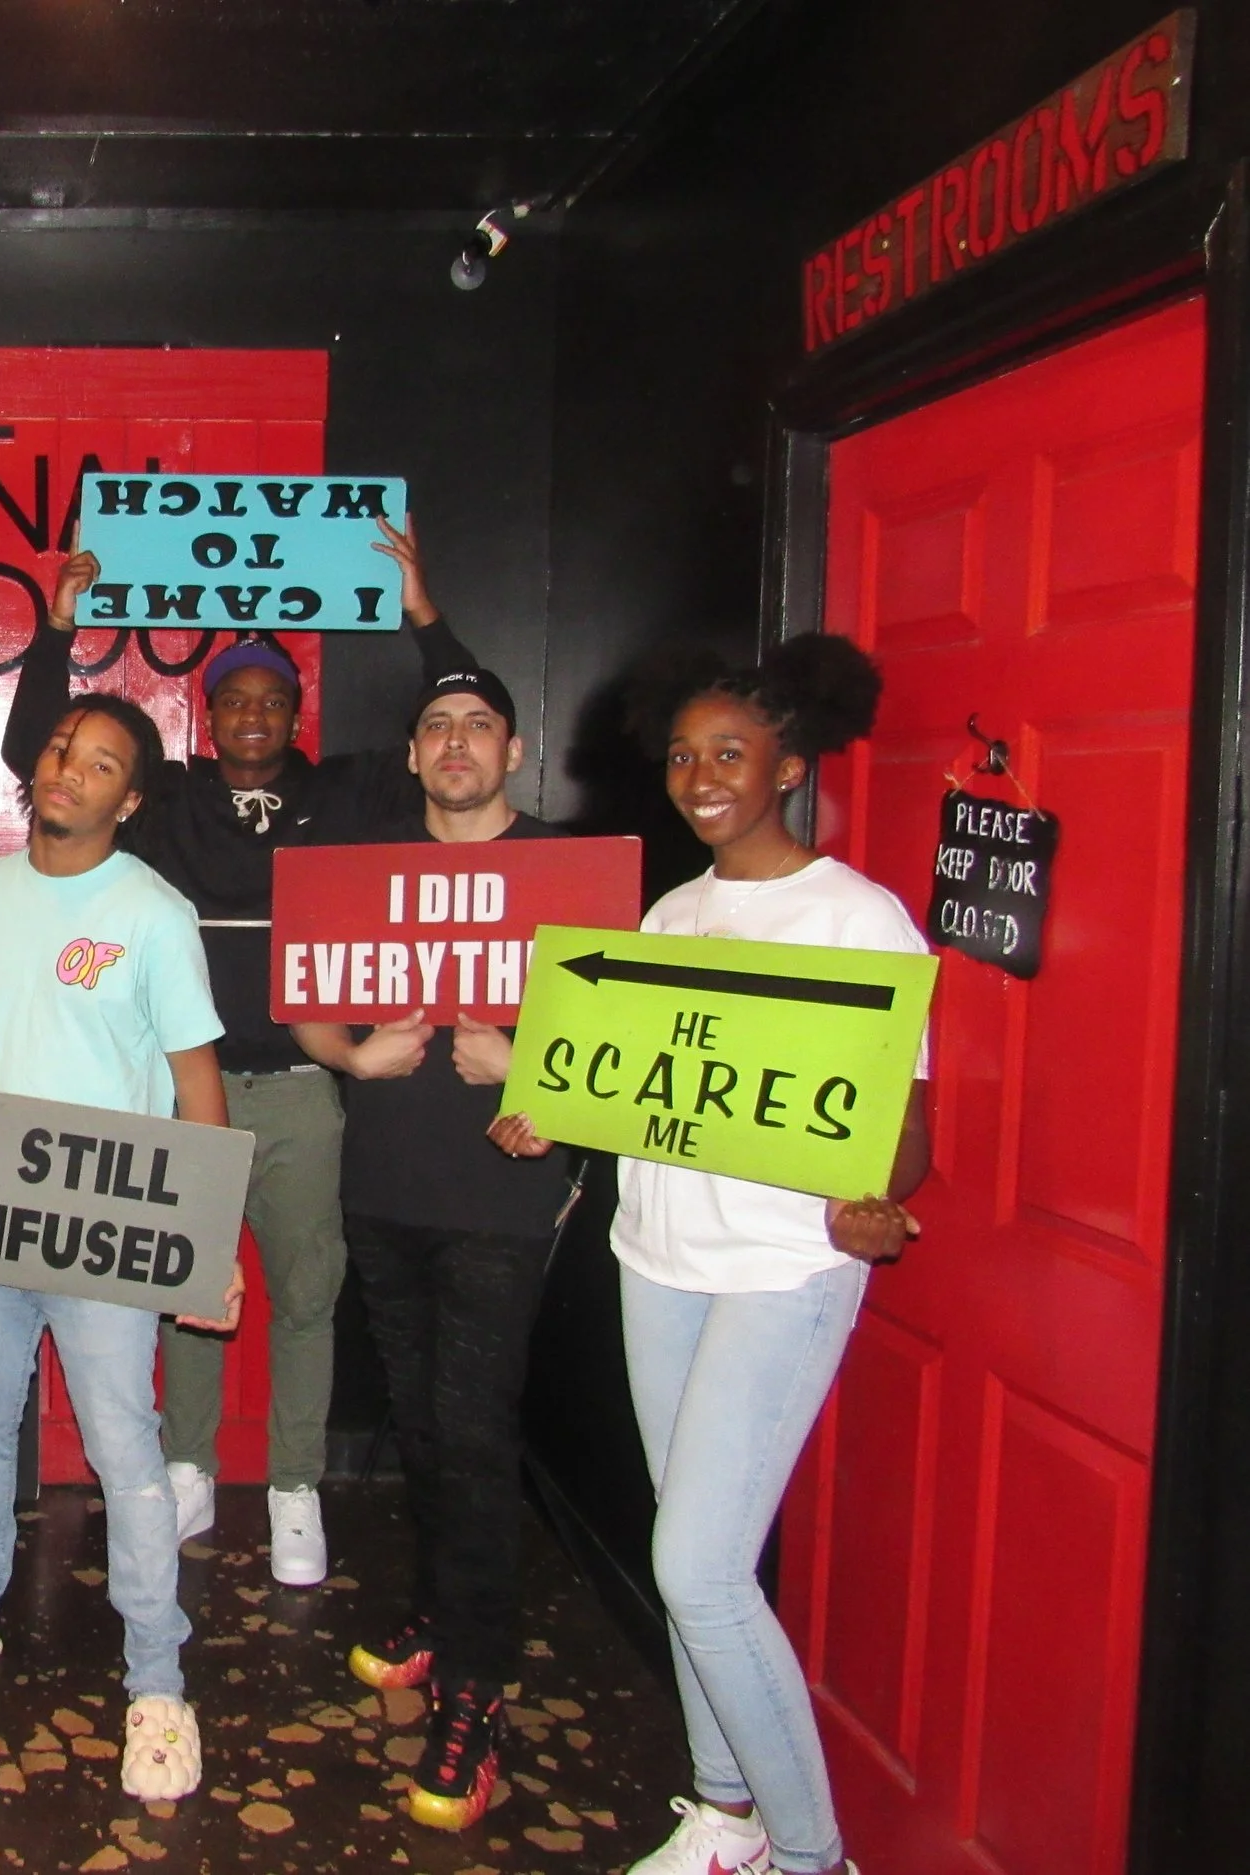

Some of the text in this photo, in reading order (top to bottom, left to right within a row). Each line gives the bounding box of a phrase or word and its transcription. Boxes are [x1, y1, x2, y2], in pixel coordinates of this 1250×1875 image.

[804, 33, 1171, 352] RESTROOMS
[95, 480, 390, 519] WATCH
[191, 532, 284, 569] TO
[91, 583, 384, 622] I CAME
[955, 803, 1030, 843] PLEASE
[936, 844, 1036, 896] KEEP DOOR
[389, 873, 505, 923] I DID
[56, 937, 125, 990] OF
[284, 940, 535, 1005] EVERYTH
[671, 1011, 722, 1050] HE
[537, 1037, 857, 1140] SCARES
[643, 1114, 703, 1158] ME
[17, 1127, 179, 1206] STILL
